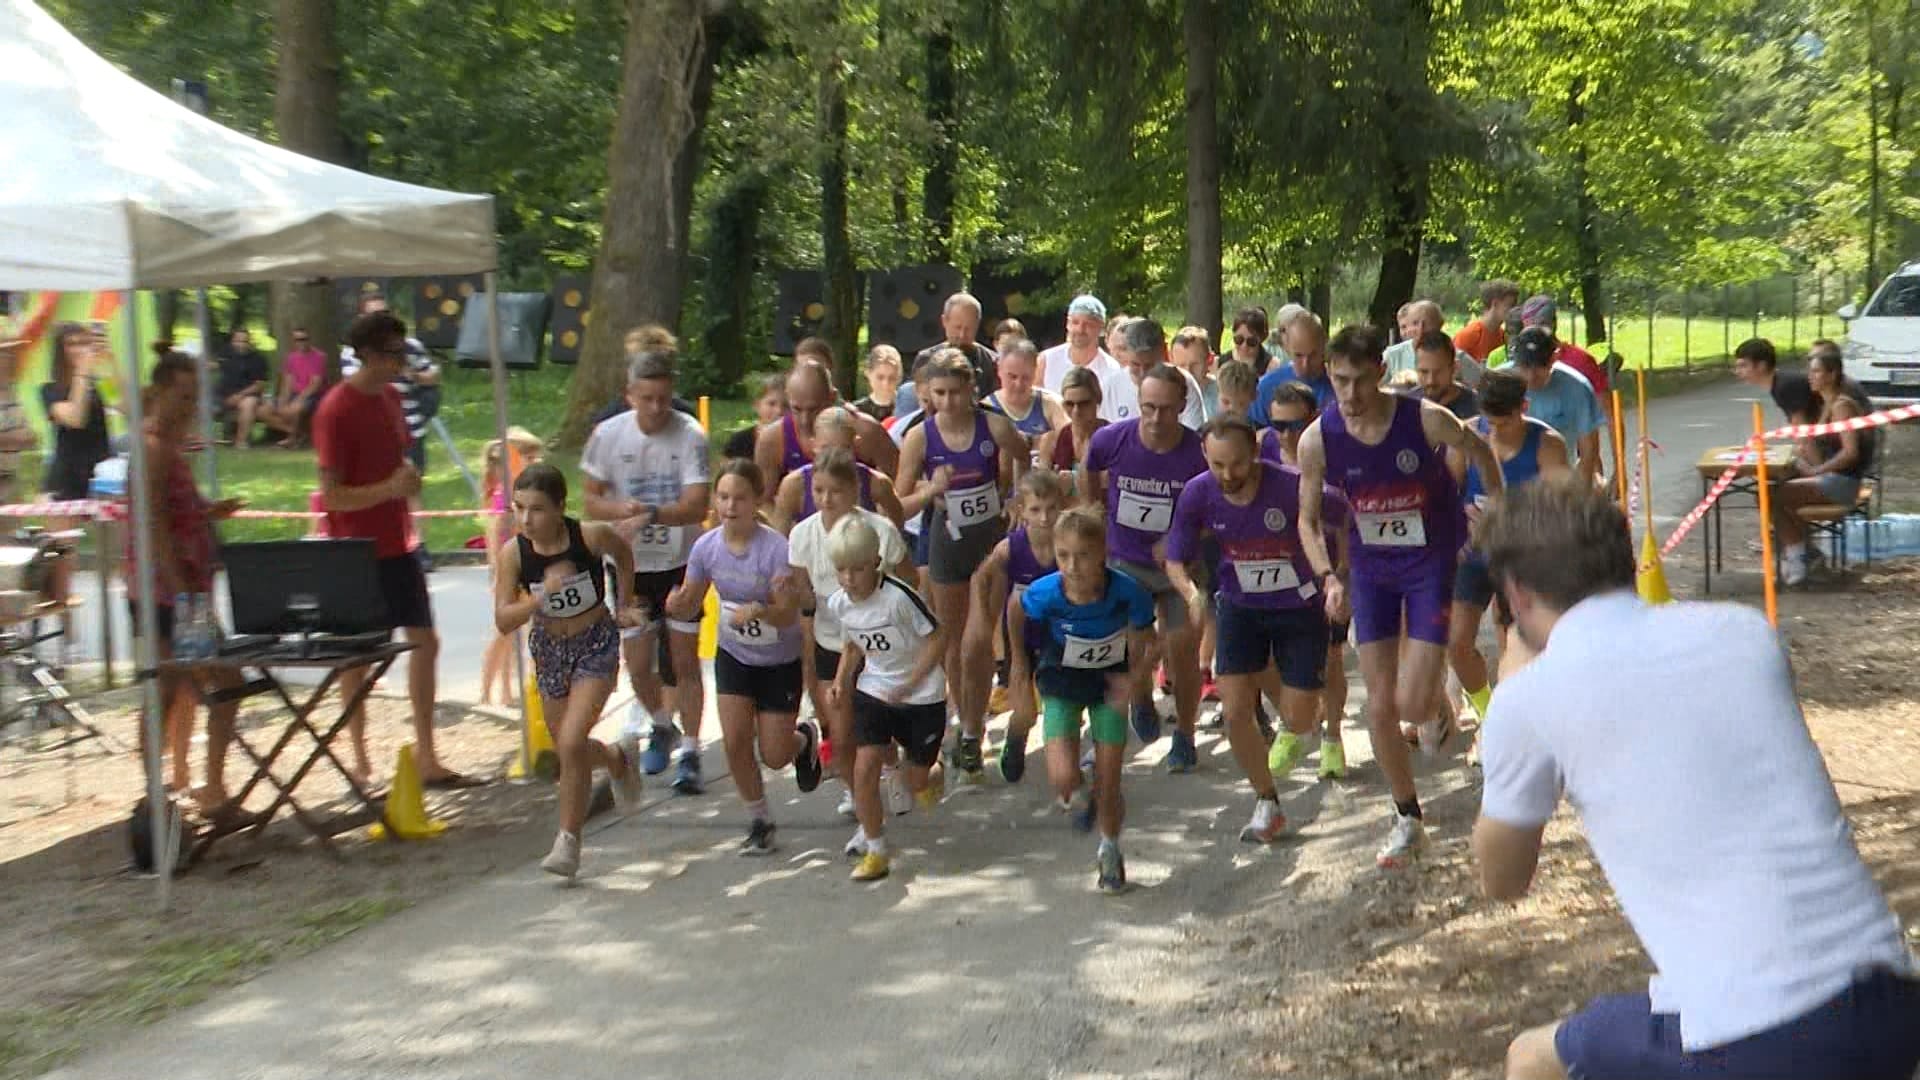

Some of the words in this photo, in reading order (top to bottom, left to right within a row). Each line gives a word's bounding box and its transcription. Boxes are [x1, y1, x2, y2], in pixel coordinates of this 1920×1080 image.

[961, 496, 989, 518] 65
[1139, 506, 1152, 523] 7
[641, 526, 670, 545] 93
[1376, 519, 1408, 538] 78
[1250, 568, 1280, 587] 77
[549, 587, 582, 610] 58
[859, 632, 891, 652] 28
[1078, 644, 1112, 663] 42
